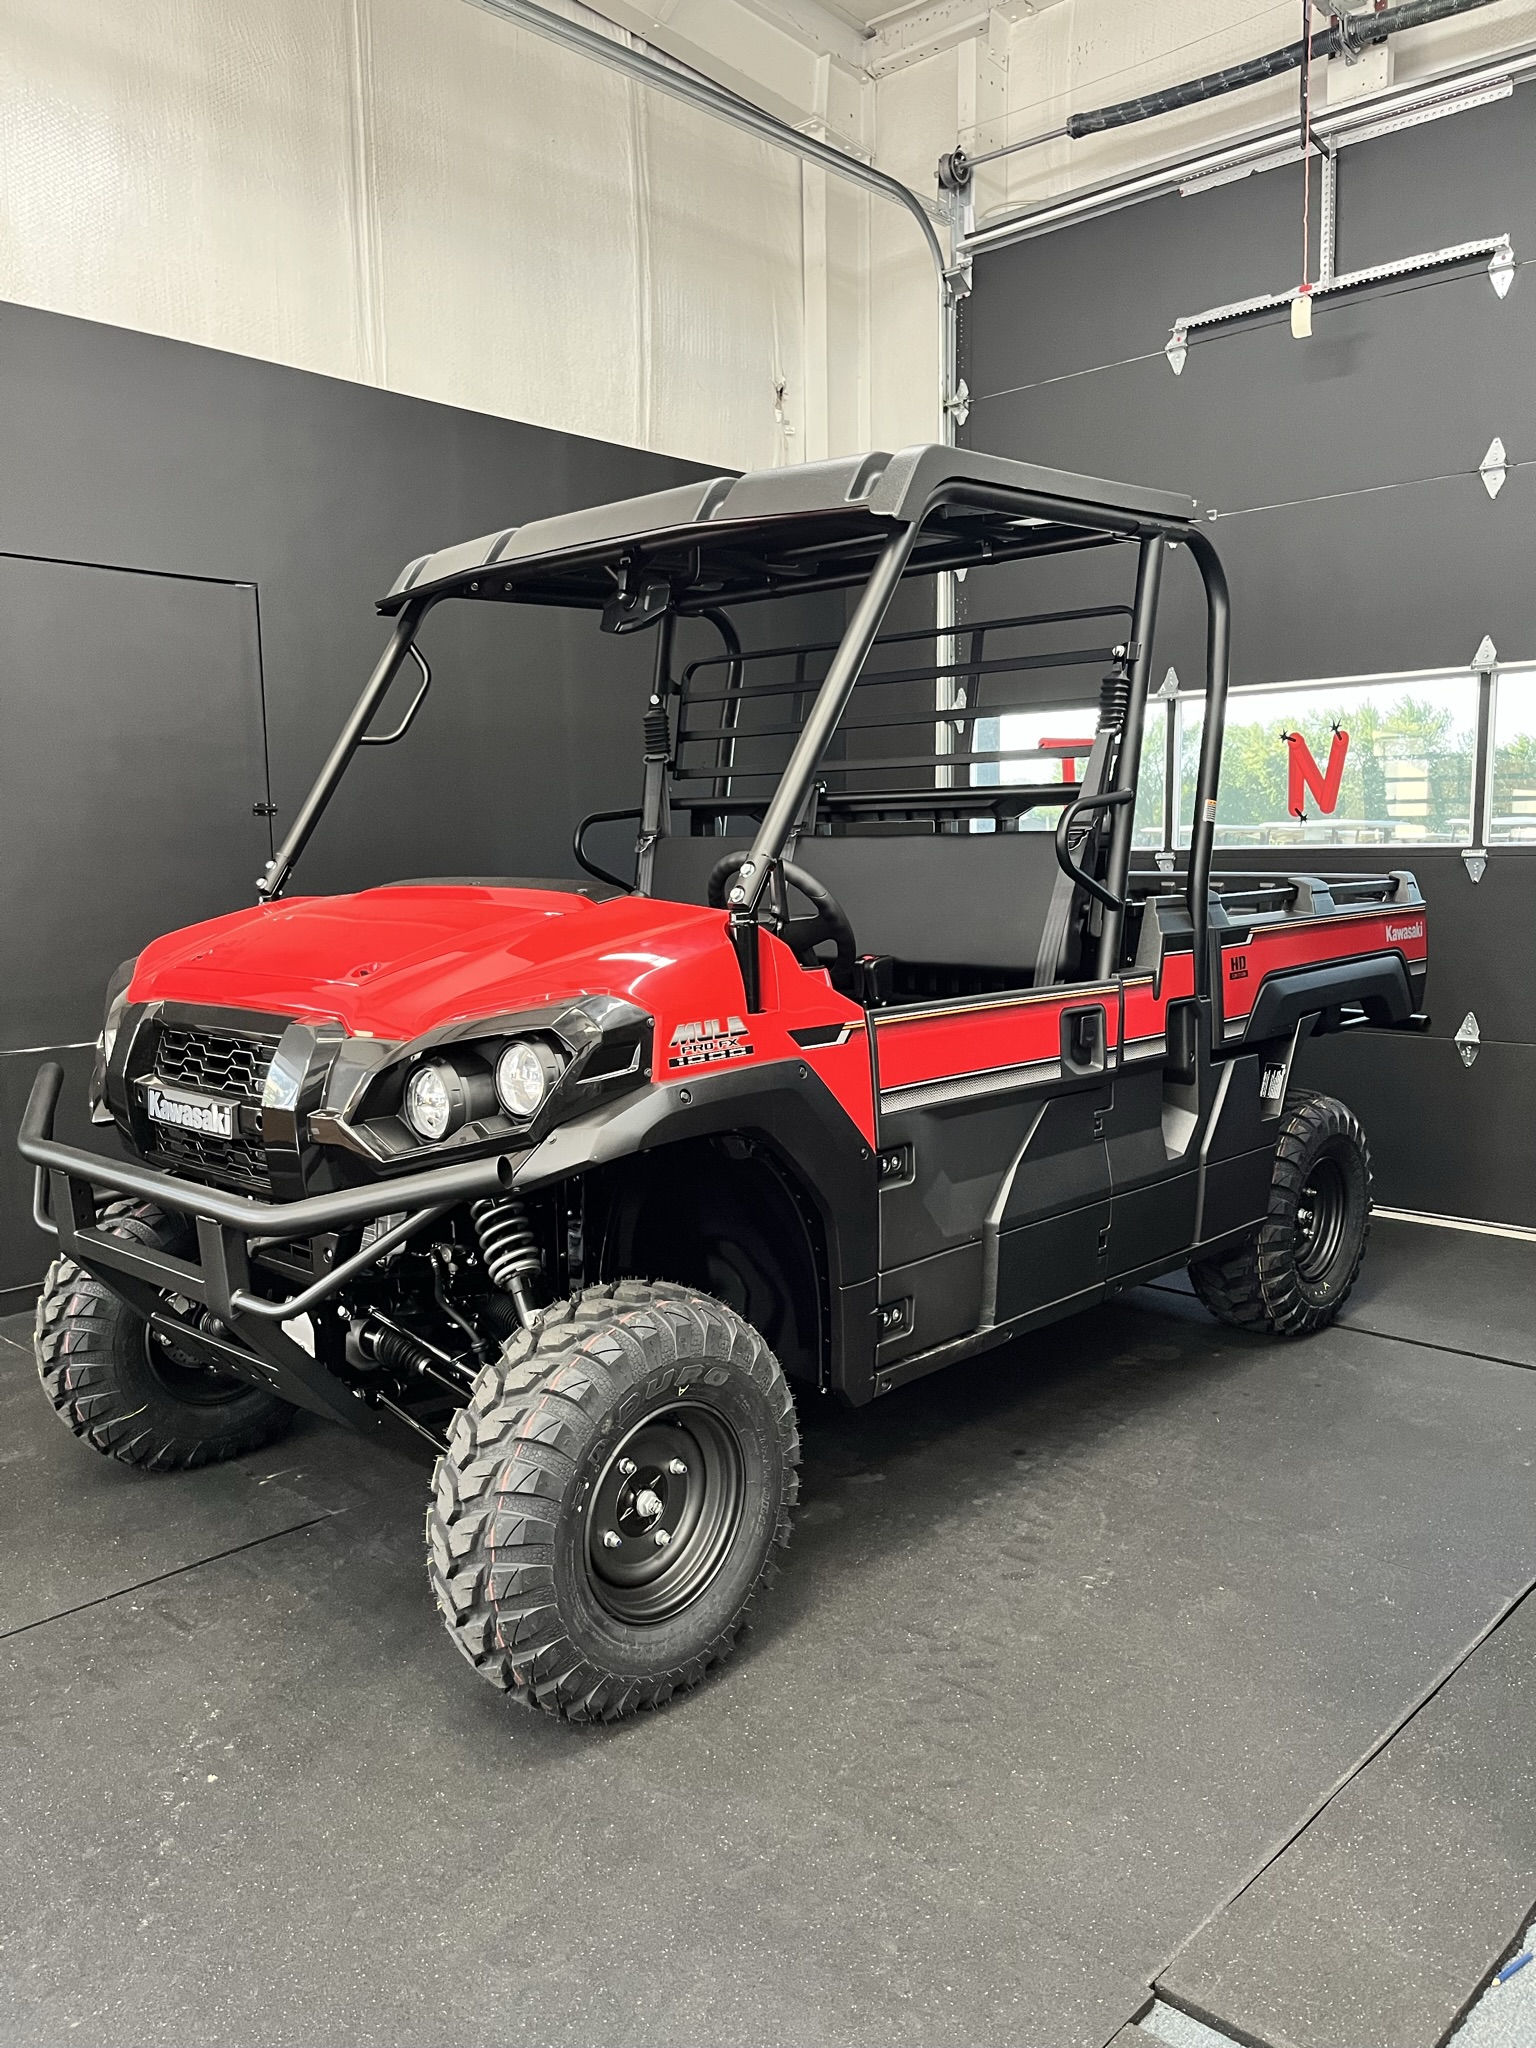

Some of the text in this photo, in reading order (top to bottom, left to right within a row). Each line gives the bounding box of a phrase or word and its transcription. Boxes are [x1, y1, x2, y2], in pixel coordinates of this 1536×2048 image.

[1287, 730, 1349, 818] N
[1385, 921, 1423, 942] Kawasaki
[1230, 955, 1246, 971] HD
[681, 1038, 738, 1054] PRO FX
[676, 1049, 748, 1066] 1000
[149, 1089, 231, 1136] Kawasaki
[618, 1364, 730, 1429] DURO
